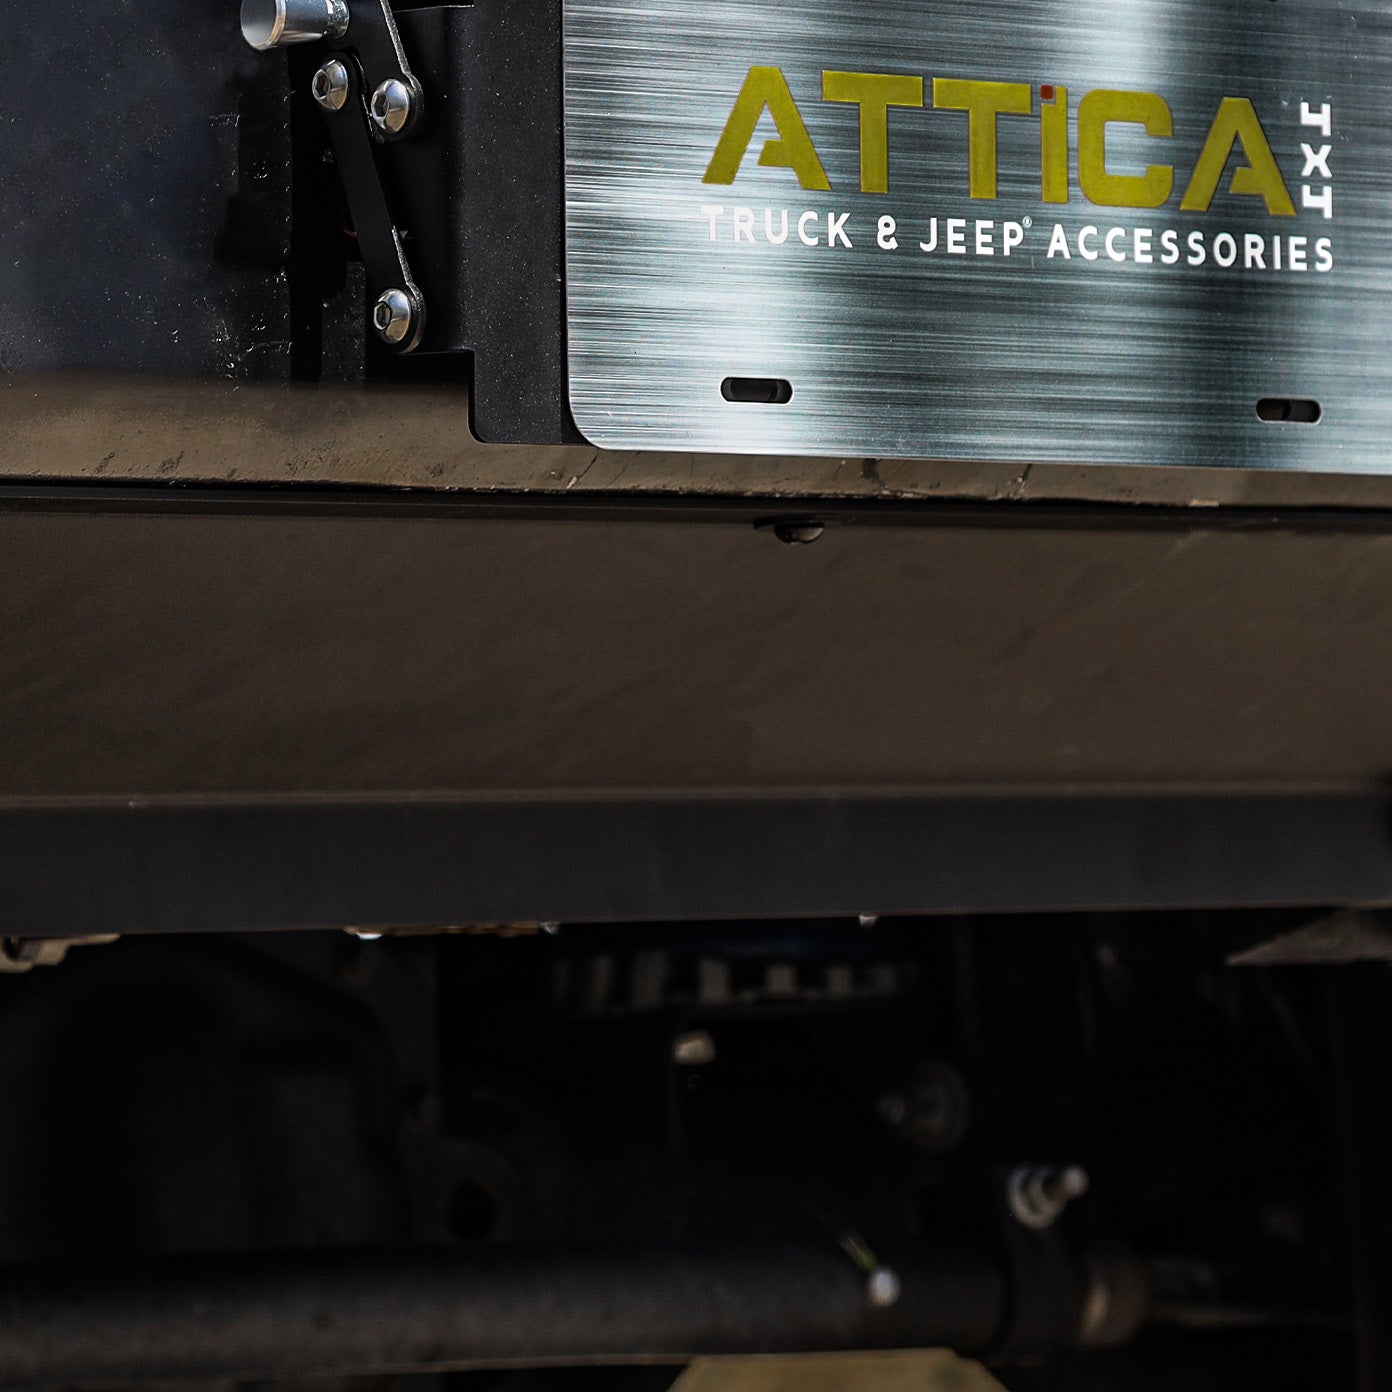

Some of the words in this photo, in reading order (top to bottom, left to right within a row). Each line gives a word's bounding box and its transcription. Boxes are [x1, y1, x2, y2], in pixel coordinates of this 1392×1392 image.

[700, 205, 854, 249] TRUCK
[876, 214, 899, 250] &
[1046, 223, 1334, 273] ACCESSORIES
